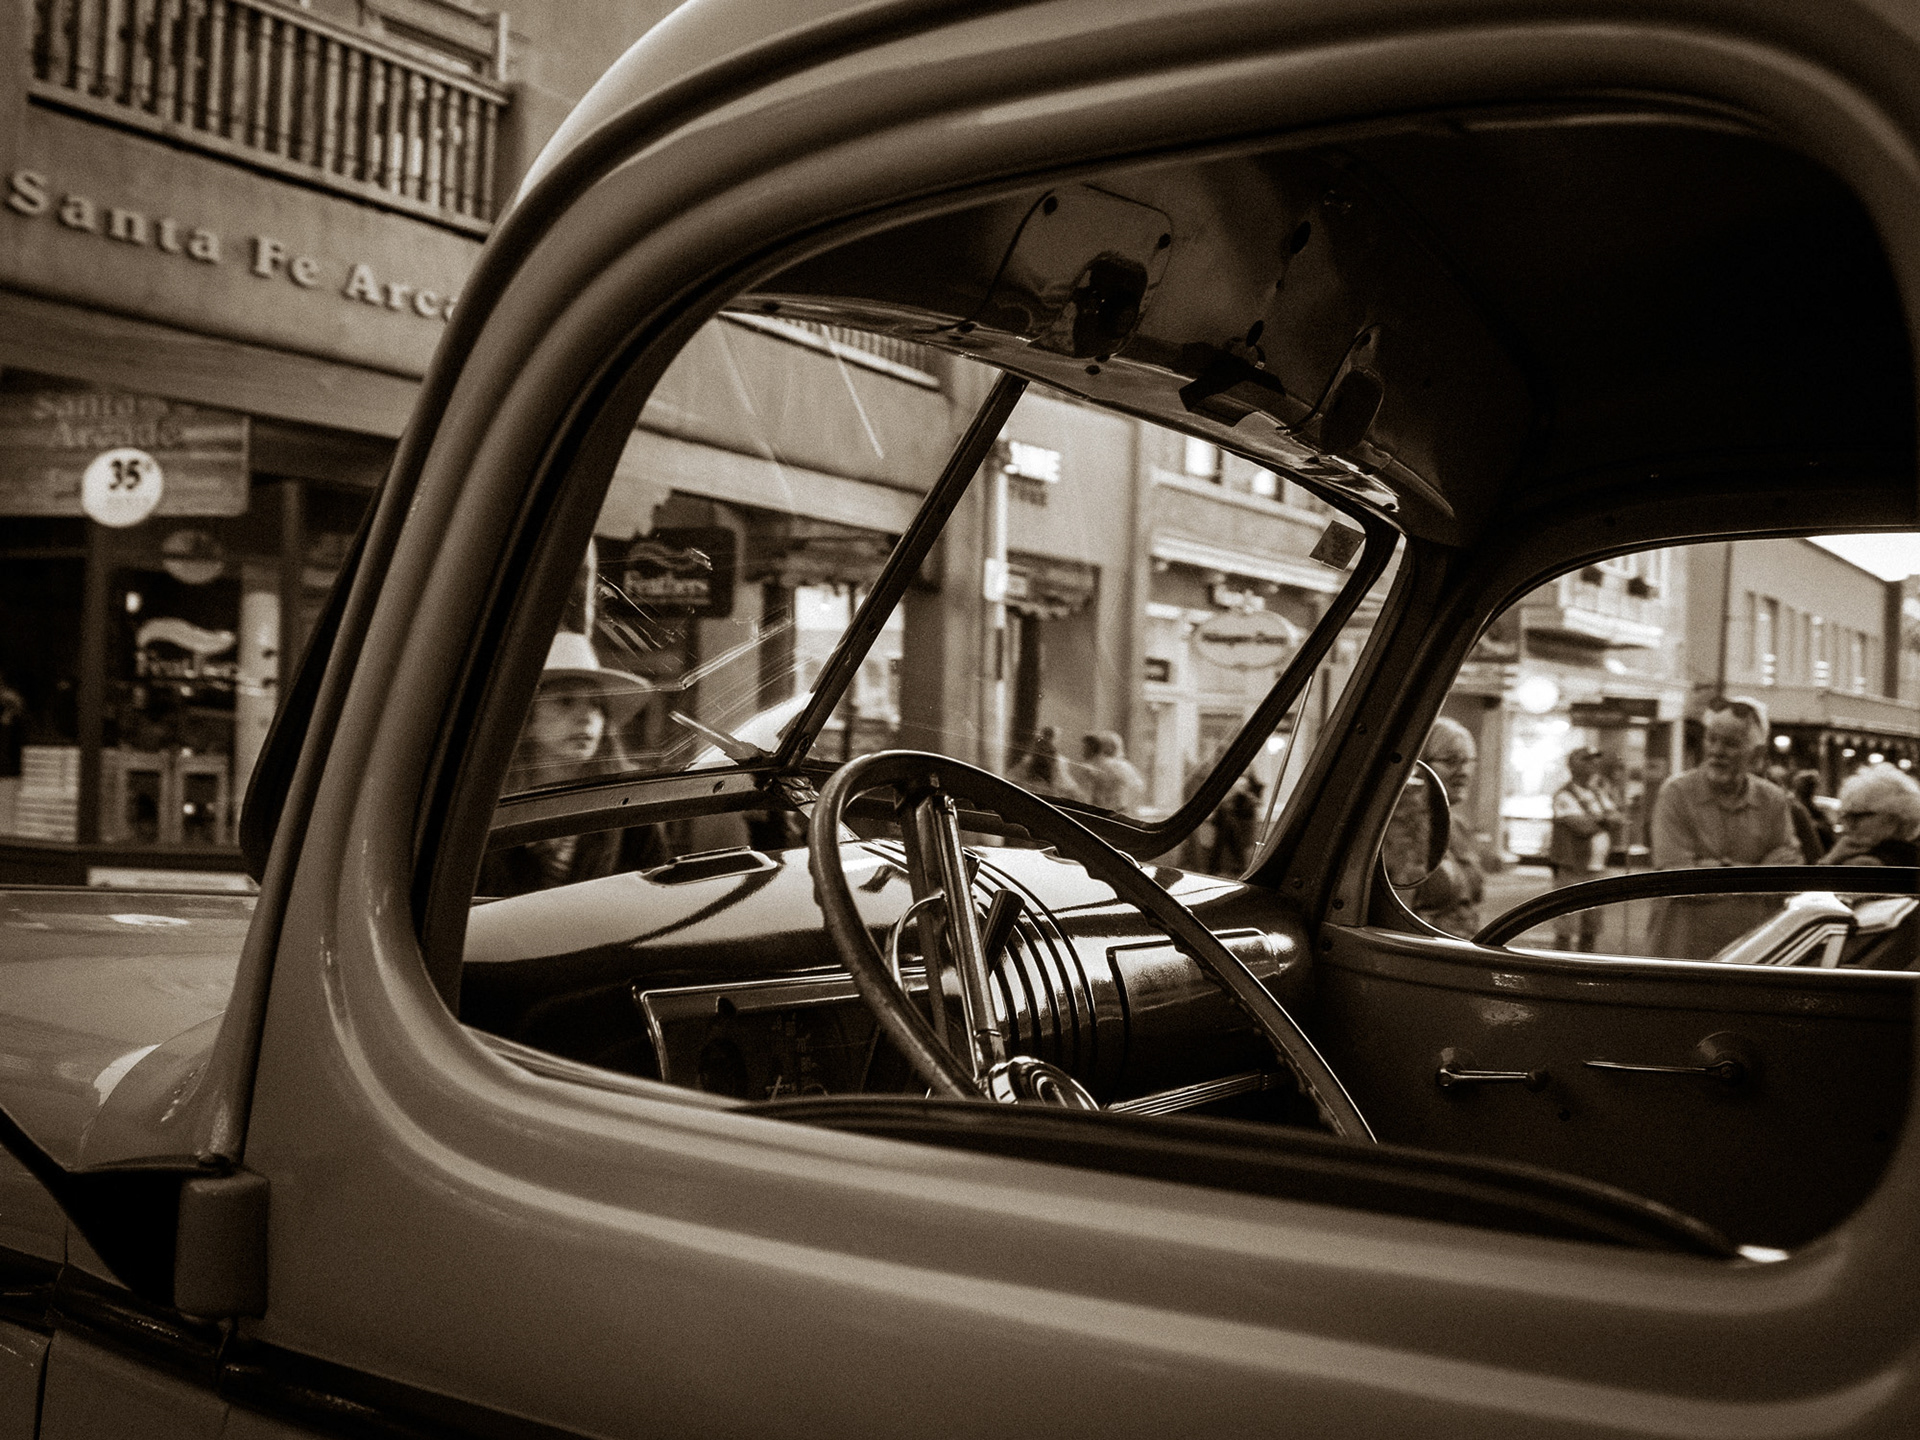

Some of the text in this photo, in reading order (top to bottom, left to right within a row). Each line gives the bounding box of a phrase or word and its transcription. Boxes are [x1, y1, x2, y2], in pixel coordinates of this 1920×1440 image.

[8, 169, 222, 265] Santa
[250, 234, 322, 288] Fe
[108, 458, 143, 491] 35
